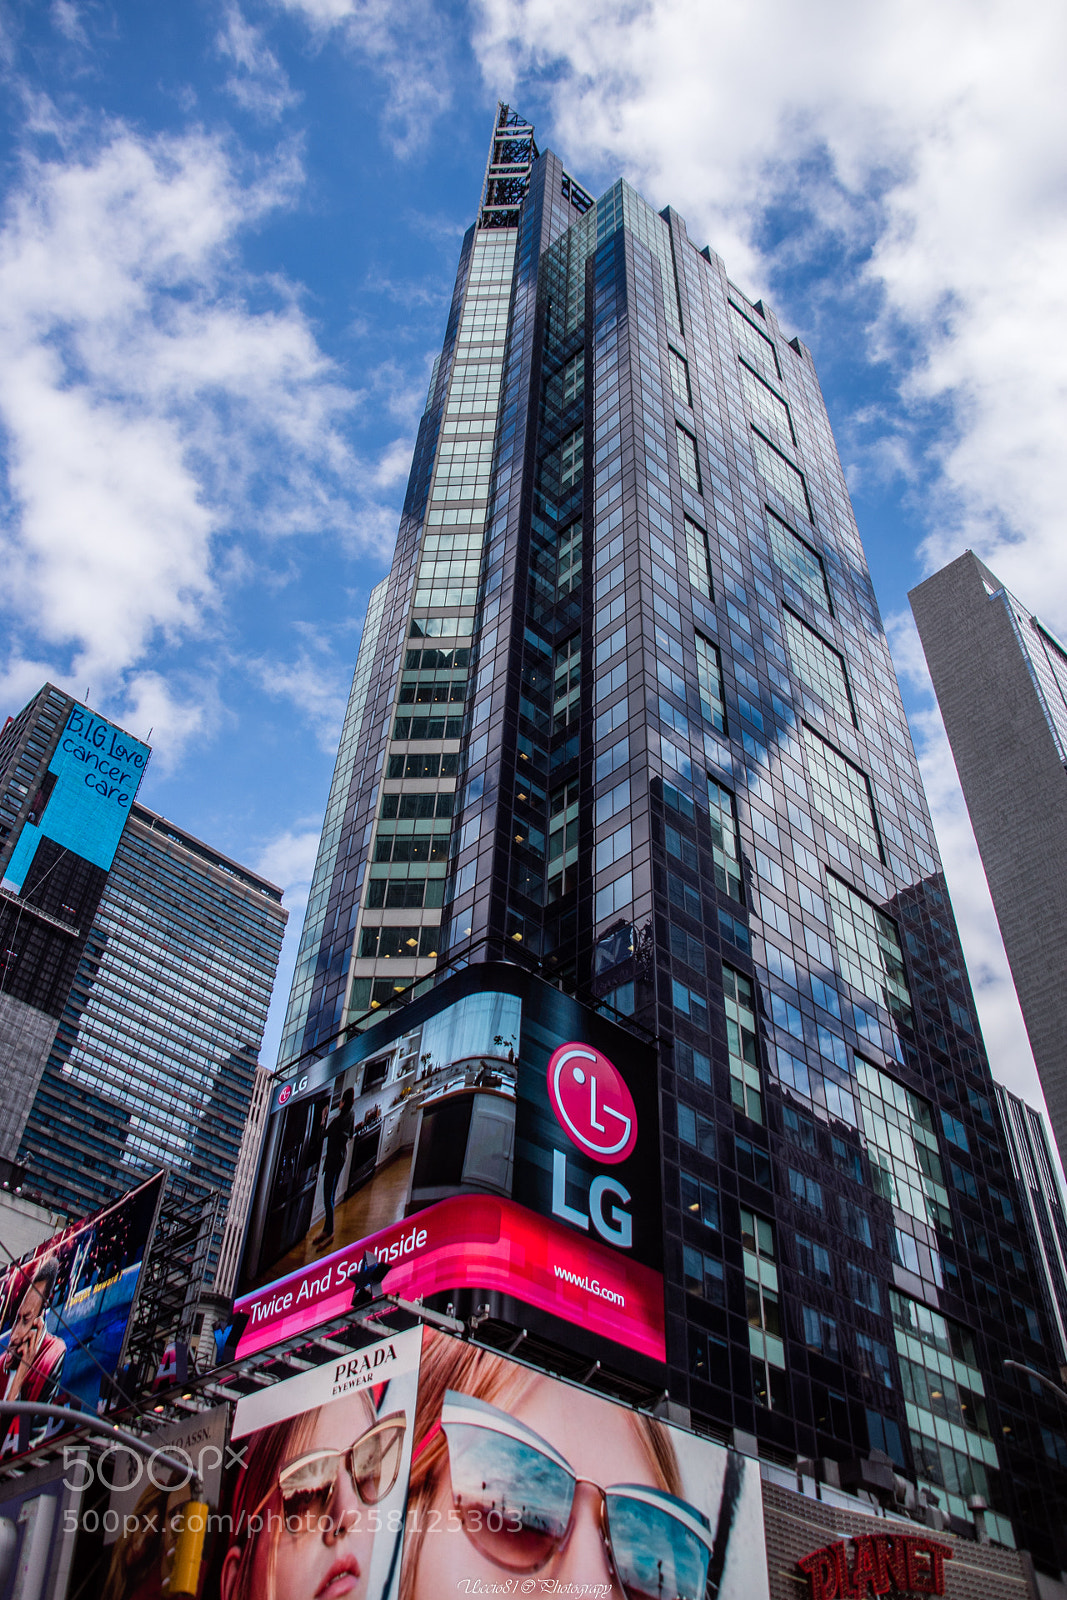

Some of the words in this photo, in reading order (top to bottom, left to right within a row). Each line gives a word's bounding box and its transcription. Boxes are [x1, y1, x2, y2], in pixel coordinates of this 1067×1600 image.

[66, 708, 107, 751] B.I.G.
[107, 732, 145, 769] Love
[62, 738, 132, 785] cancer
[84, 773, 129, 808] care
[291, 1075, 308, 1097] LG
[552, 1148, 633, 1248] LG
[250, 1292, 293, 1324] Twice
[296, 1267, 333, 1304] And
[553, 1264, 625, 1307] www.LG.com
[332, 1372, 373, 1396] EYEWEAR
[334, 1343, 398, 1383] PRADA
[185, 1426, 211, 1447] ASSN.
[798, 1534, 953, 1600] PLANET
